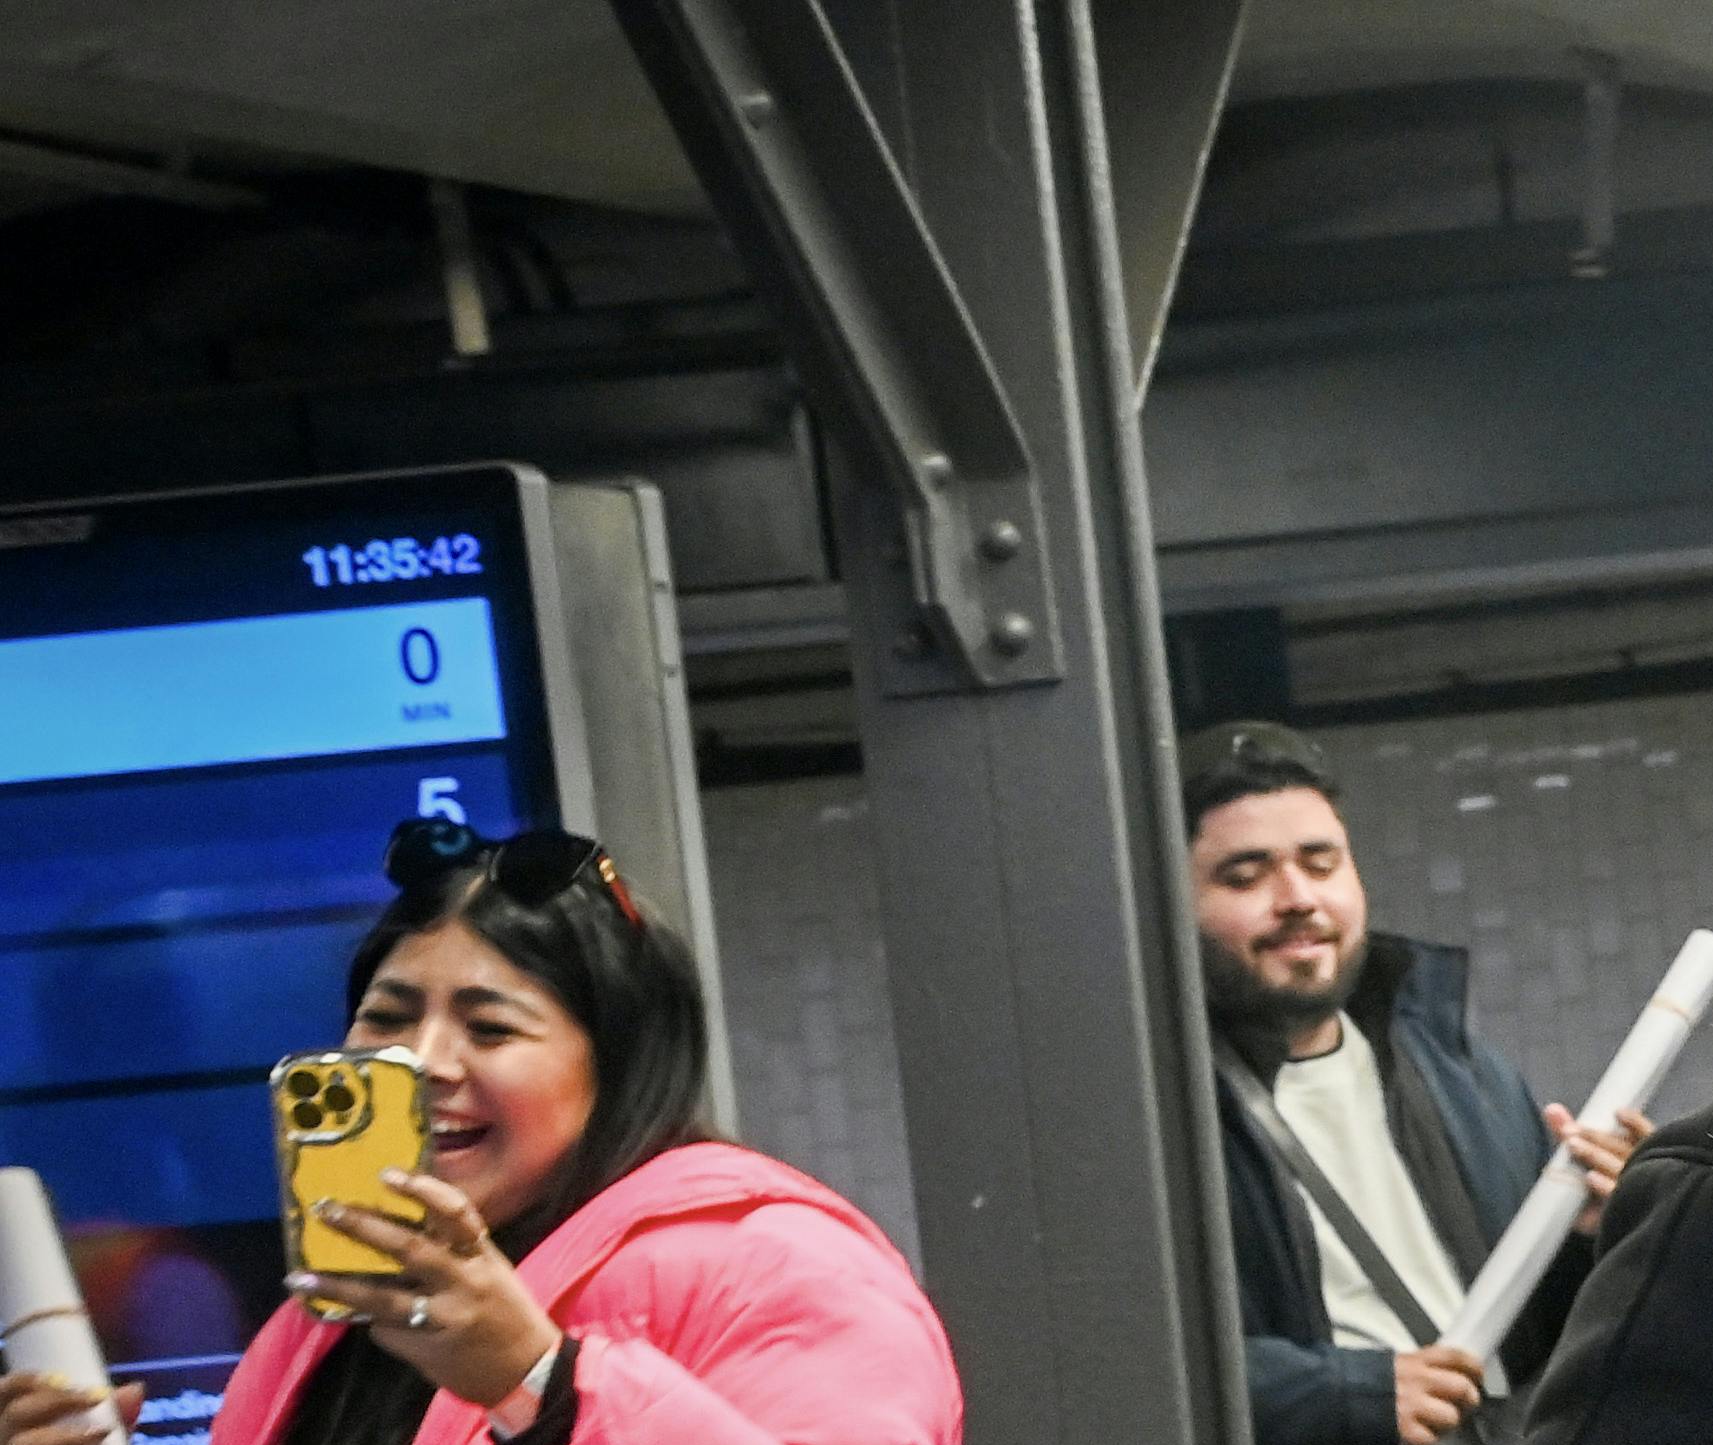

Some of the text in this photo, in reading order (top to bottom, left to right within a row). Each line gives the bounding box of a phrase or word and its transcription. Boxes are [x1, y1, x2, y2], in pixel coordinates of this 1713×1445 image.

[303, 533, 483, 587] 11:35:42
[400, 627, 440, 685] 0
[402, 703, 451, 722] MIN
